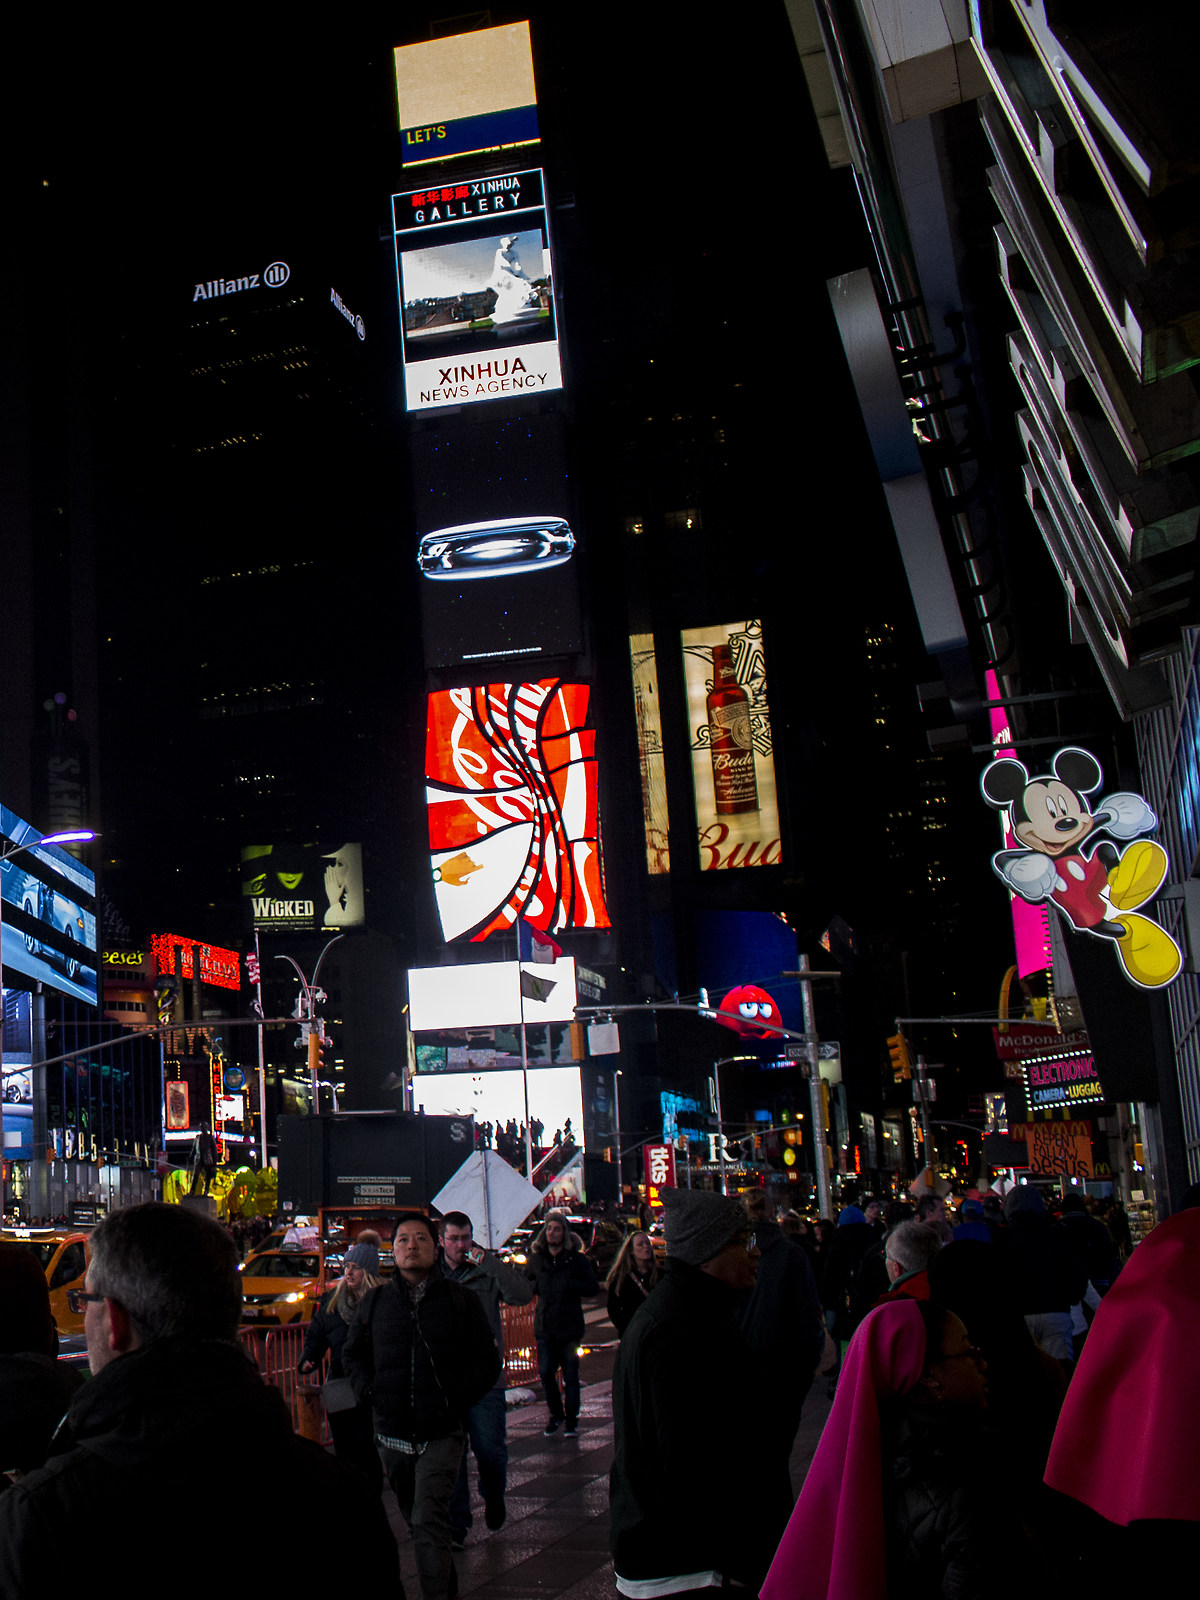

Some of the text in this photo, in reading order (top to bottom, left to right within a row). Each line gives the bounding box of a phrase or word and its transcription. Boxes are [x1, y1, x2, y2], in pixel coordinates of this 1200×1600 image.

[406, 125, 447, 145] LET'S
[471, 176, 521, 196] XINHUA
[415, 192, 521, 223] GALLERY
[192, 274, 261, 302] Allianz
[438, 356, 527, 386] XINHUA
[419, 372, 549, 404] NEWS AGENCY
[101, 949, 145, 966] eese's
[1033, 1086, 1067, 1104] CAMERA
[707, 1132, 739, 1163] R
[1034, 1130, 1076, 1149] REPENT
[1033, 1144, 1078, 1162] FOLLOW
[649, 1146, 668, 1185] tkts
